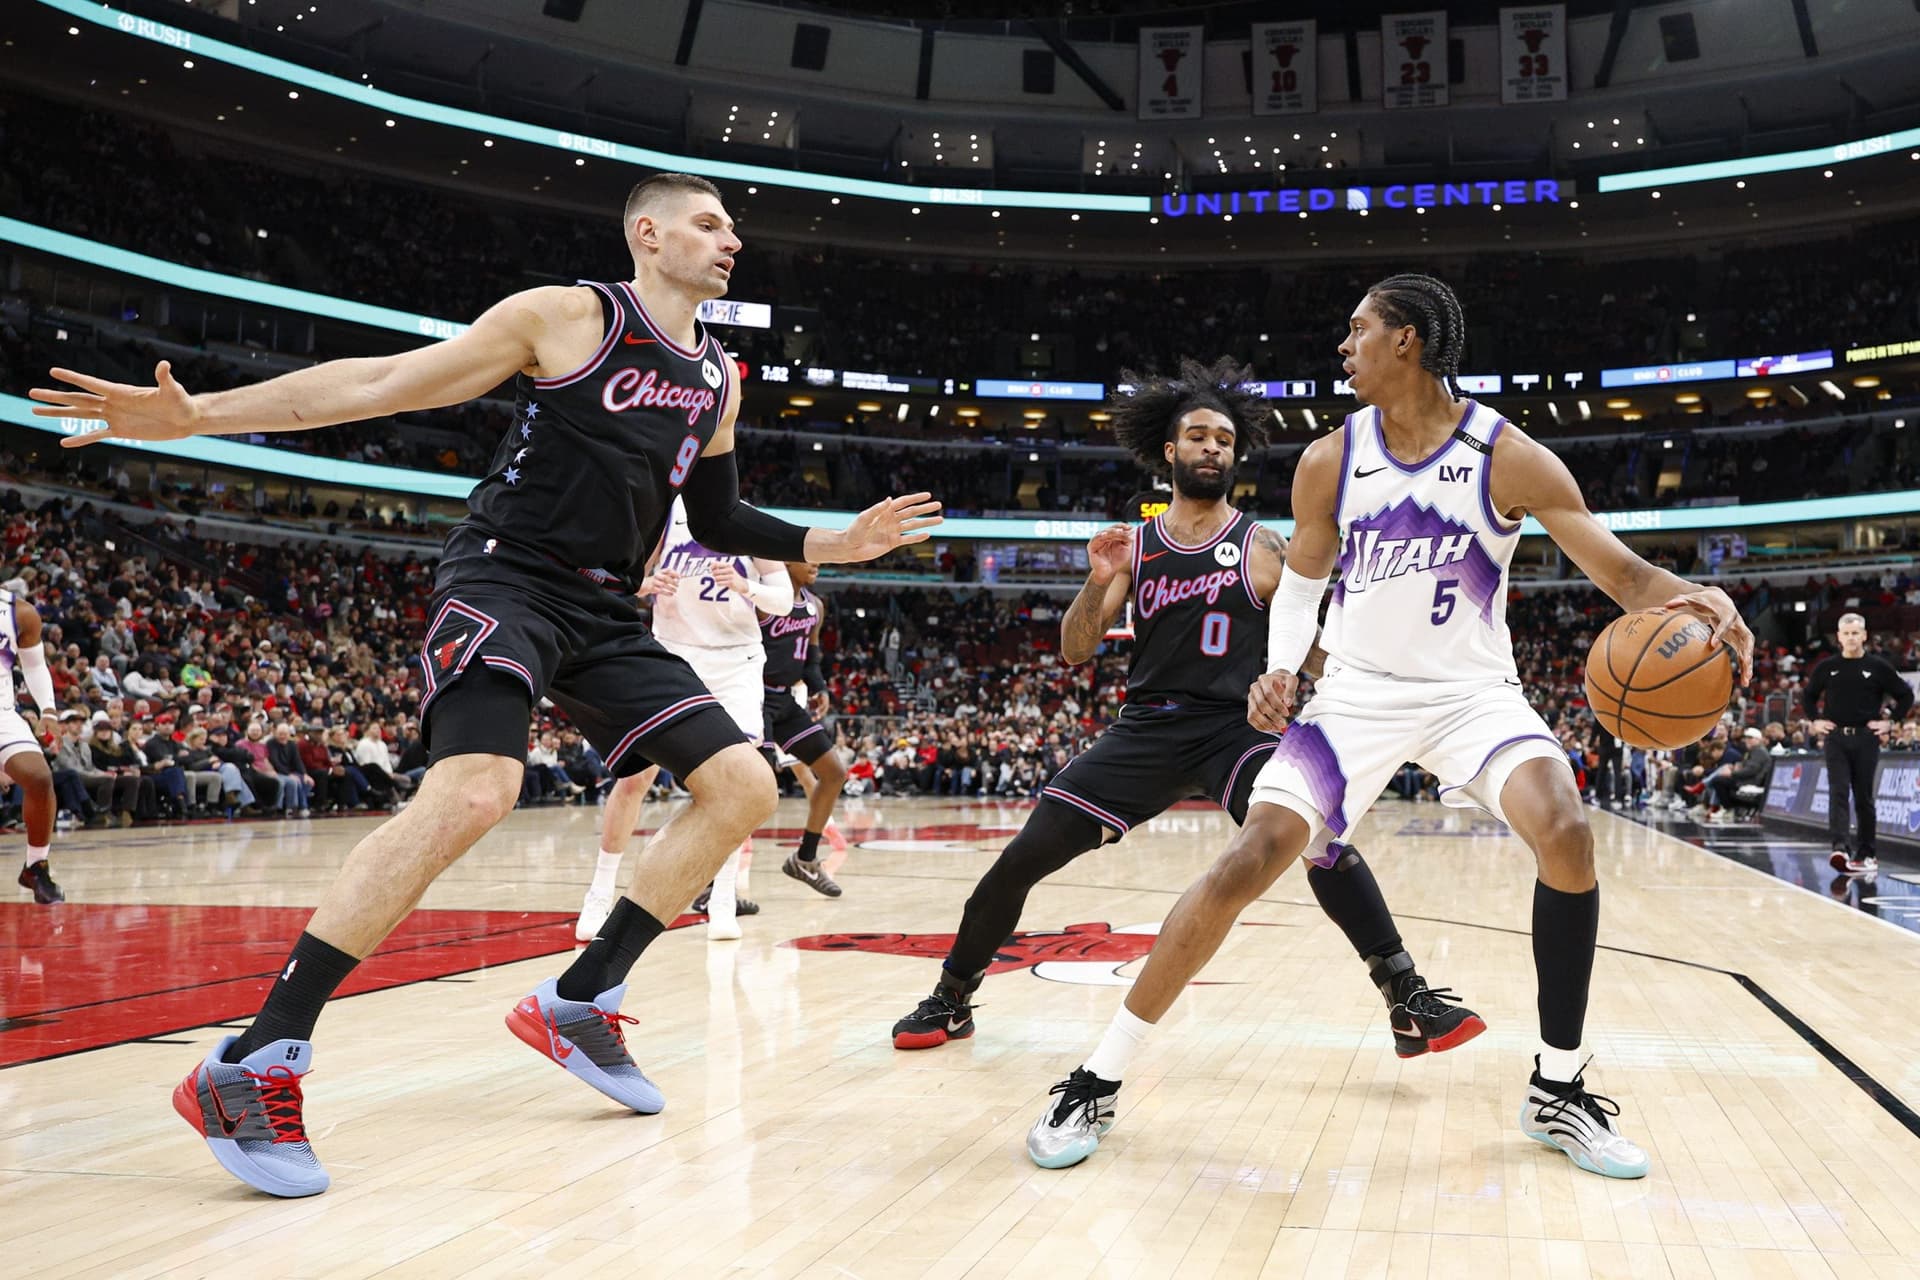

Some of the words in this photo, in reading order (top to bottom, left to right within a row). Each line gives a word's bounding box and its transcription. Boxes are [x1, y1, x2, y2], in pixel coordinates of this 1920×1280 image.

[137, 18, 192, 49] RUSH
[1400, 60, 1430, 85] 23
[1519, 54, 1549, 78] 33
[1271, 69, 1297, 93] 10
[574, 134, 616, 159] RUSH
[1847, 135, 1891, 158] RUSH
[943, 188, 983, 204] RUSH
[1162, 188, 1336, 217] UNITED
[1383, 179, 1560, 208] CENTER
[602, 367, 715, 426] Chicago
[668, 434, 700, 488] 9
[1439, 465, 1473, 483] LVT
[1052, 521, 1099, 538] RUSH
[1611, 510, 1661, 530] RUSH
[1344, 528, 1479, 593] UTAH
[699, 576, 730, 602] 22
[1138, 569, 1240, 620] Chicago
[1431, 579, 1459, 626] 5
[1201, 611, 1231, 656] 0
[793, 636, 809, 660] 11
